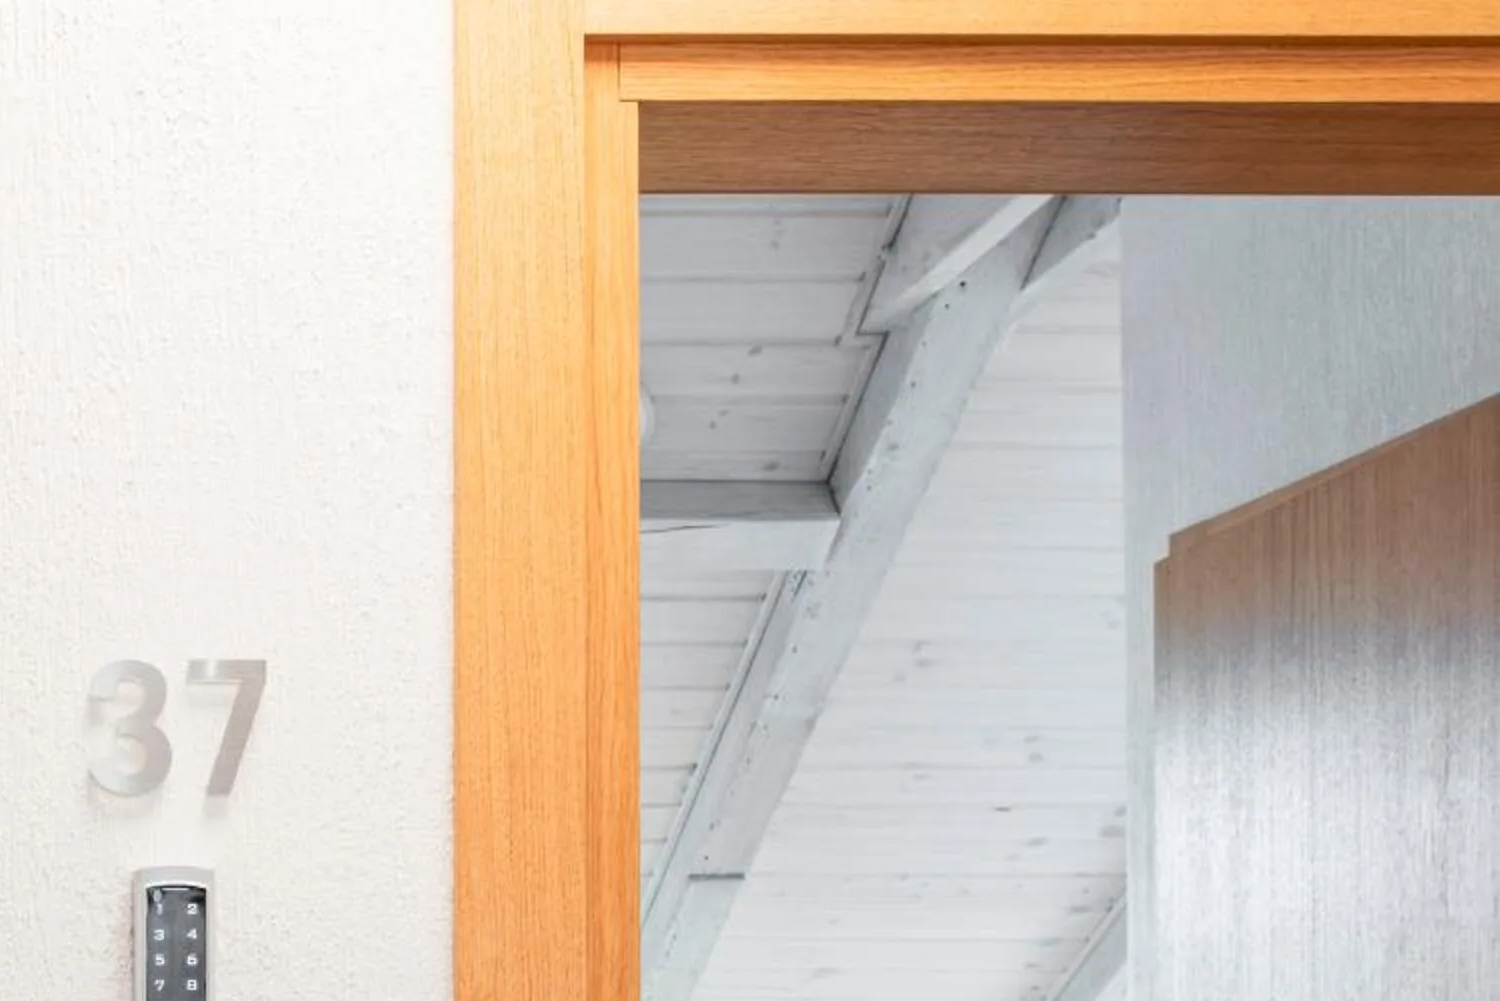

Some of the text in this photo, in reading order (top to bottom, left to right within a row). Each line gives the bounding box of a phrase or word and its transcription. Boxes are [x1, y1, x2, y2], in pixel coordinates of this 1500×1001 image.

[86, 658, 268, 798] 37
[186, 903, 198, 915] 2
[153, 928, 198, 941] 3 4
[154, 953, 198, 966] 5 6
[154, 979, 198, 992] 7 8
